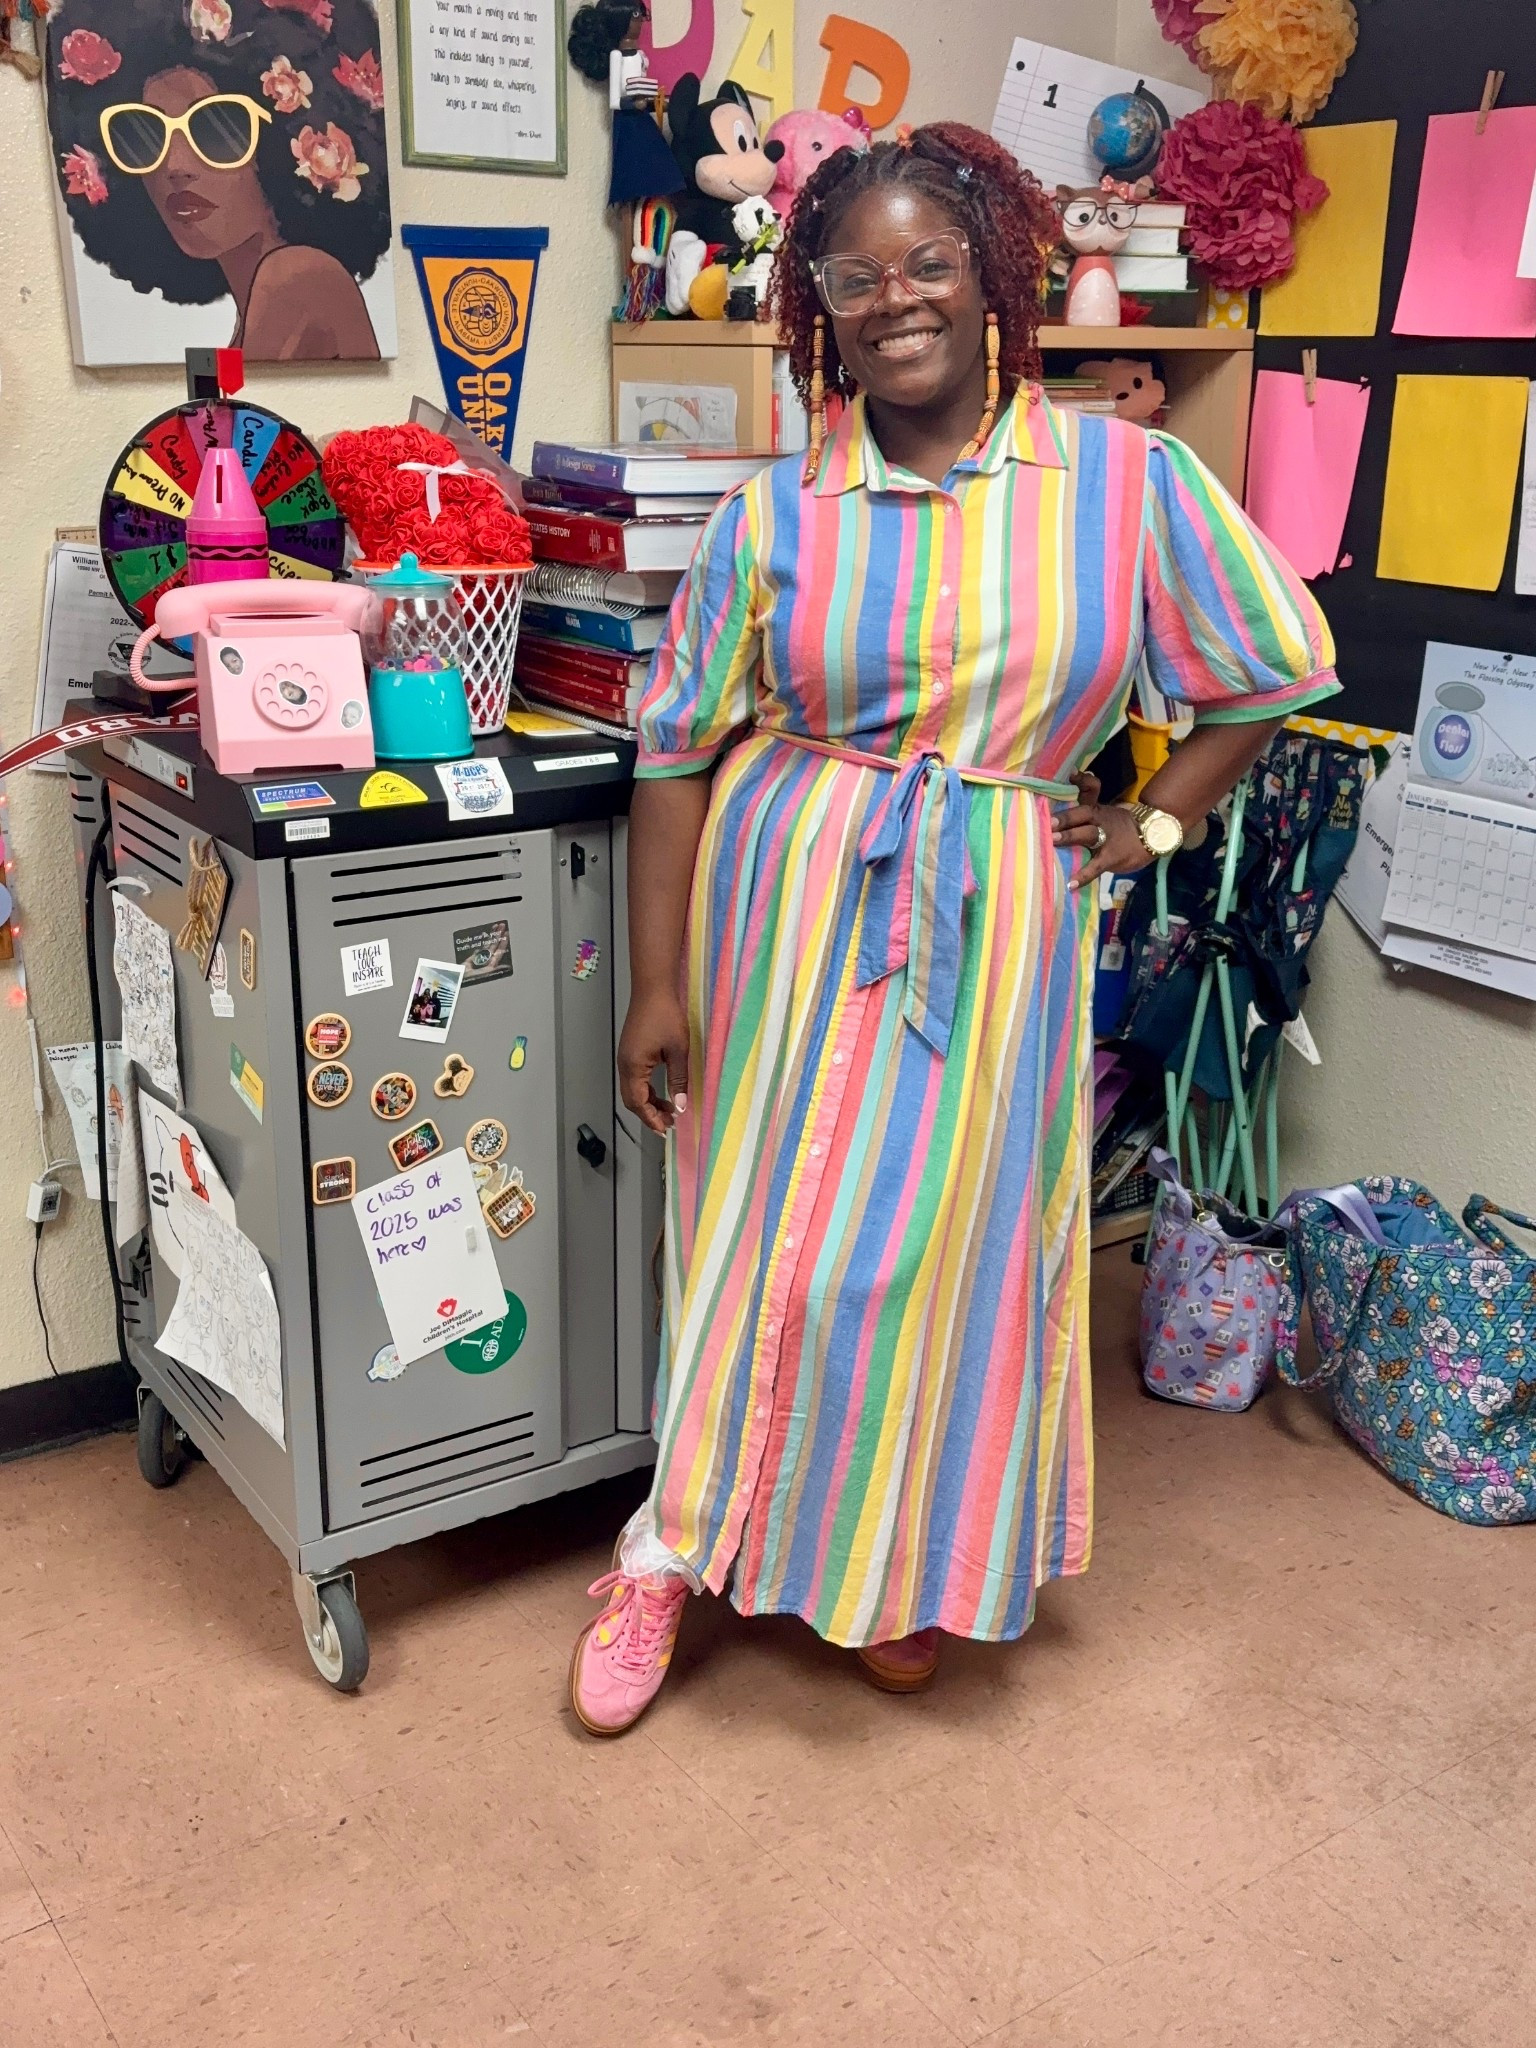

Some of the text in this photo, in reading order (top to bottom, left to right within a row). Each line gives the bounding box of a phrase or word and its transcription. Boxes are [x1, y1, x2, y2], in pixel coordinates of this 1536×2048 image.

[436, 0, 538, 22] Your mouth is moving and there
[429, 24, 435, 34] is
[439, 26, 449, 37] any
[454, 27, 466, 38] kind
[470, 28, 477, 39] of
[481, 31, 498, 42] sound
[502, 33, 519, 46] coming
[434, 48, 446, 59] This
[449, 50, 472, 62] includes
[475, 53, 495, 67] talking
[499, 55, 505, 65] to
[430, 72, 450, 86] talking
[454, 74, 461, 84] to
[465, 76, 489, 89] somebody
[508, 80, 537, 95] whispering,
[1042, 83, 1059, 110] 1
[471, 100, 477, 109] or
[481, 101, 498, 112] sound
[530, 522, 571, 538] STATES HISTORY
[72, 556, 99, 566] William
[88, 588, 108, 598] Permit
[1473, 661, 1489, 671] New
[1512, 668, 1528, 678] New
[1463, 670, 1535, 691] The Flossing Odyssey
[261, 787, 306, 798] SPECTRUM
[1365, 822, 1394, 858] Emerge
[455, 936, 473, 945] Guide
[471, 941, 482, 949] and
[352, 944, 382, 961] TEACH
[357, 956, 375, 970] LOVE
[352, 965, 383, 983] INSPIRE
[318, 1072, 346, 1086] NEVER
[319, 1176, 350, 1189] STRONG
[370, 1210, 418, 1241] 2025
[428, 1197, 463, 1220] was
[377, 1243, 410, 1265] here
[422, 1309, 484, 1344] Children's Hospital
[429, 1309, 473, 1334] Joe DiMaggio
